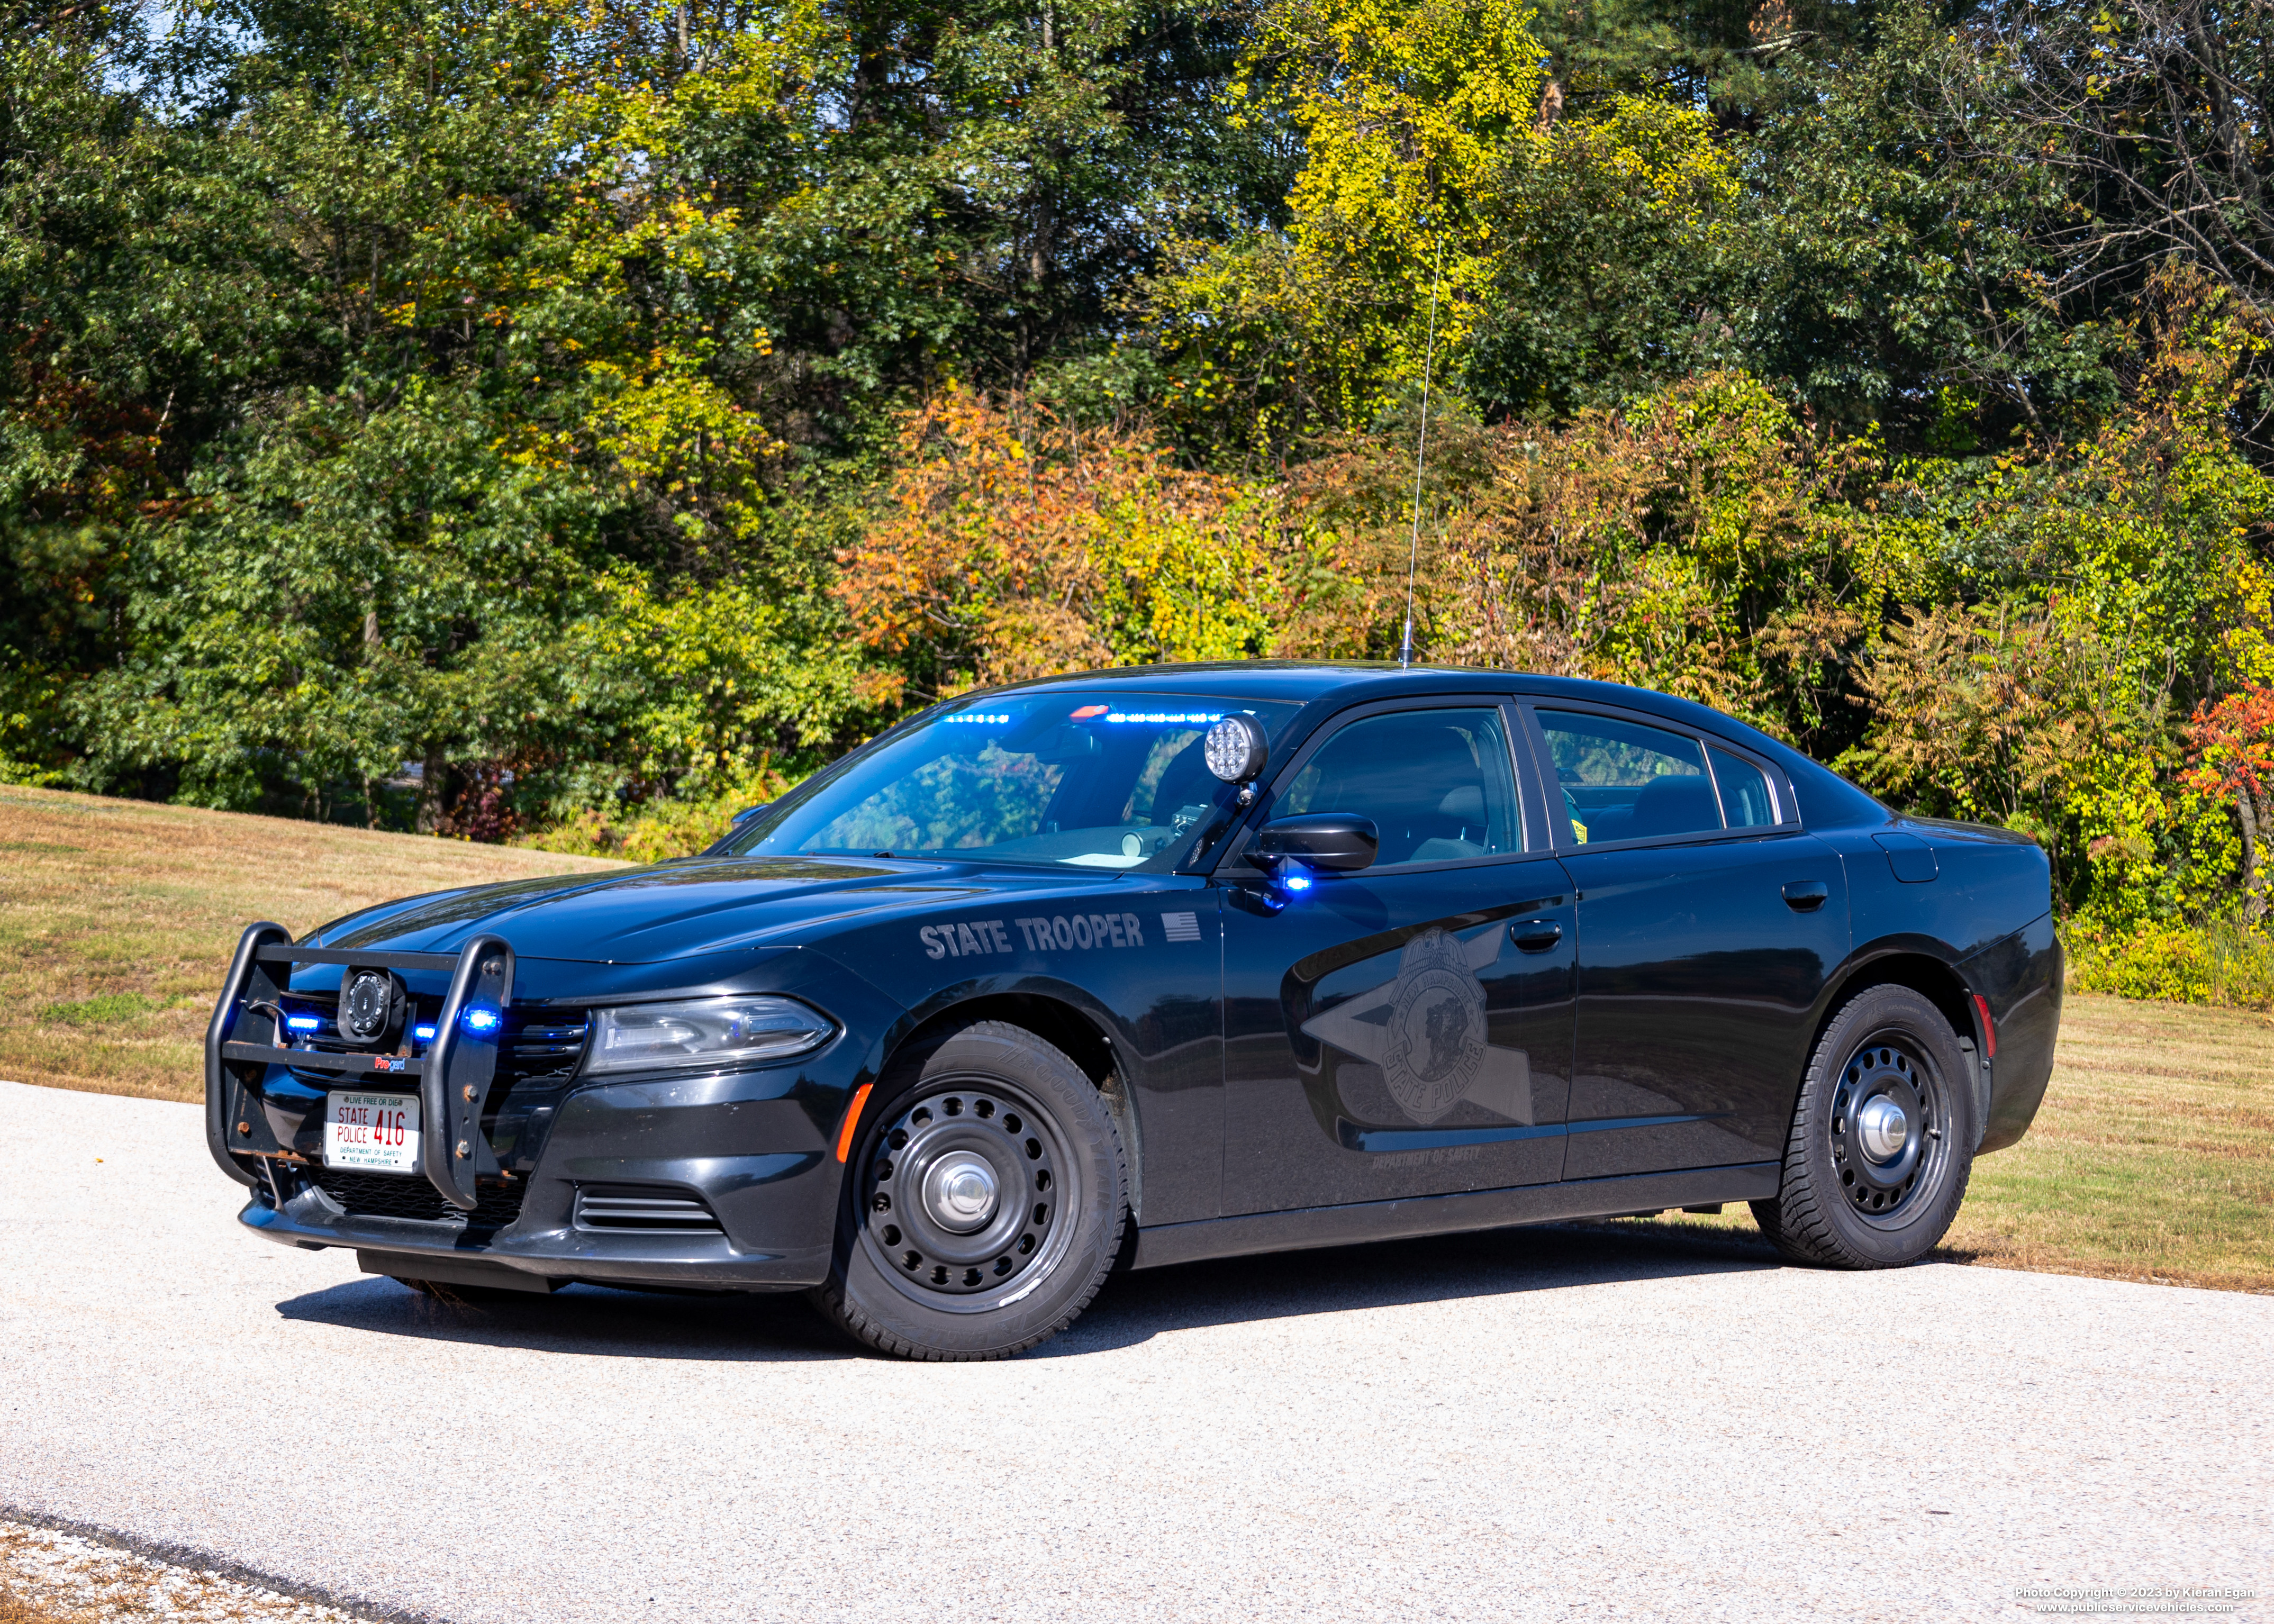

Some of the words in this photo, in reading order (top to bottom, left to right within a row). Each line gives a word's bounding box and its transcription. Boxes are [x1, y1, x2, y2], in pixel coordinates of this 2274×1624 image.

[920, 920, 1012, 959] STATE
[1016, 913, 1145, 951] TROOPER
[1402, 983, 1419, 1010] NEW
[1423, 973, 1472, 1005] HAMPSHIRE
[1385, 1049, 1426, 1109] STATE
[1432, 1042, 1484, 1109] POLICE
[339, 1106, 369, 1124] STATE
[374, 1110, 405, 1146] 416
[338, 1126, 368, 1144] POLICE
[1372, 1150, 1430, 1169] DEPARTMENT
[1433, 1149, 1448, 1164] OF
[1448, 1146, 1481, 1162] SAFETY
